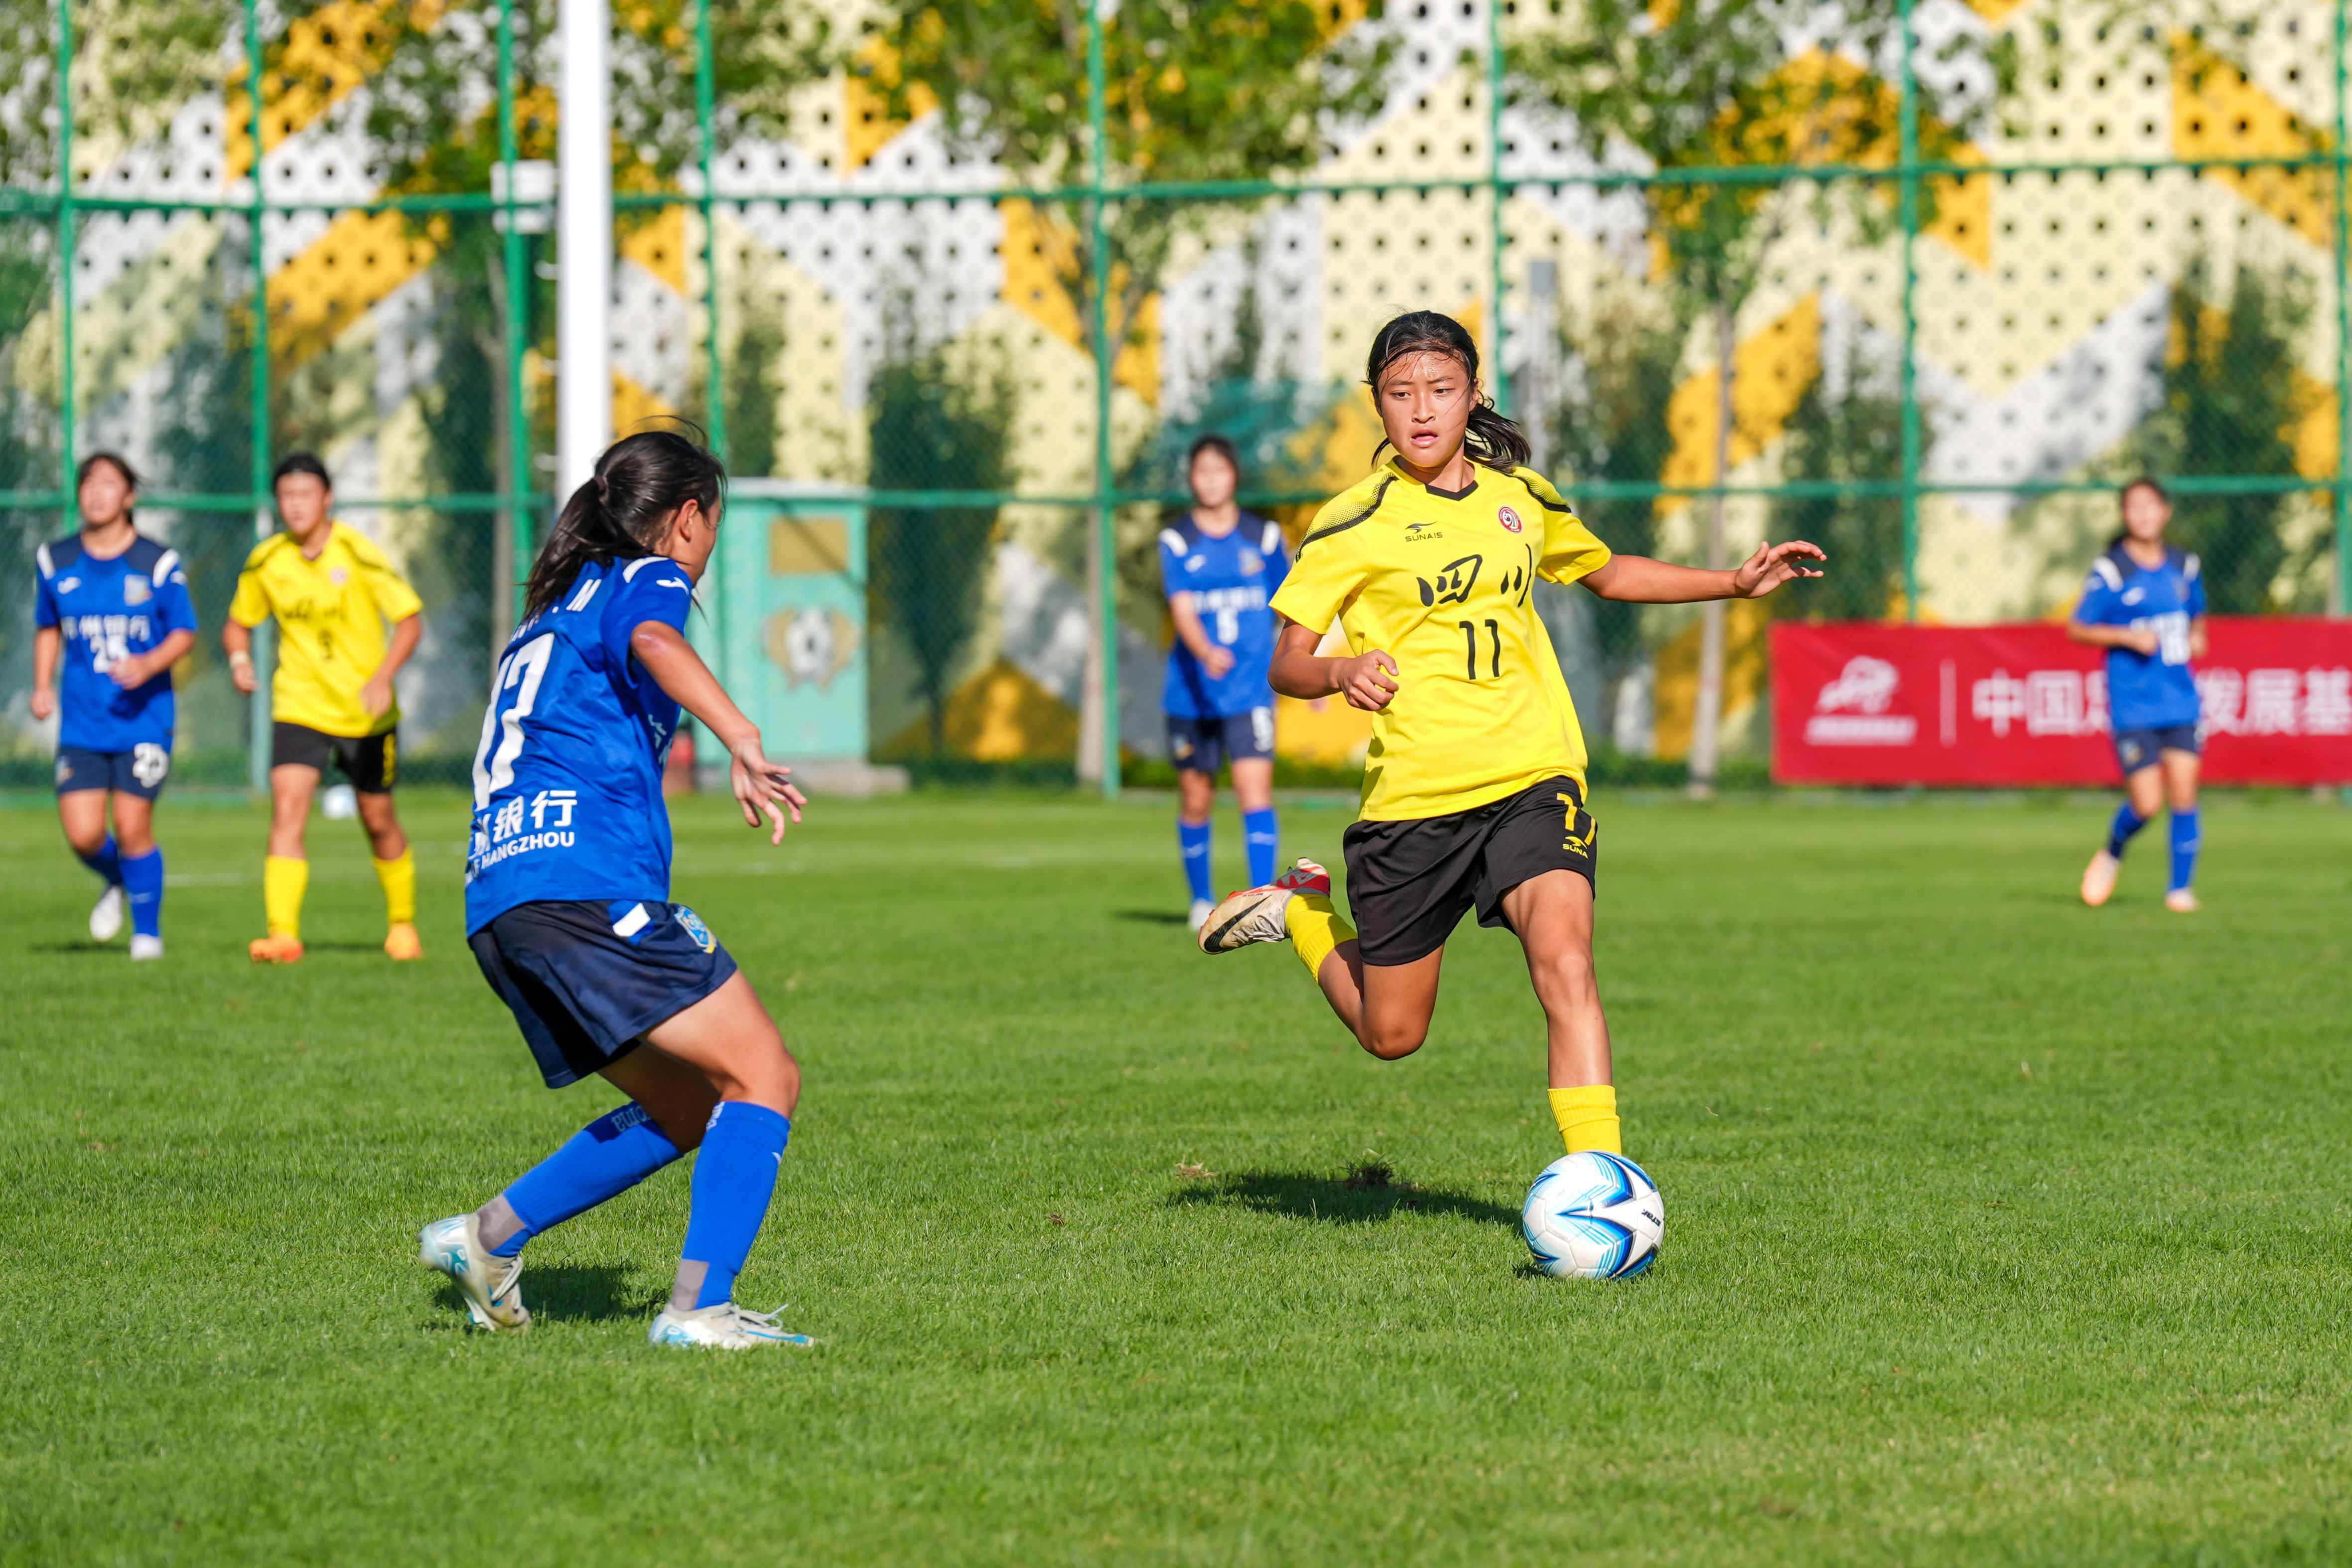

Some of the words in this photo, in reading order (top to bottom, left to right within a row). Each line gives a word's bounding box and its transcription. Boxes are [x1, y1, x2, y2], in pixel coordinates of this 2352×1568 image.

[1404, 532, 1443, 542] SUNAIS
[1416, 543, 1533, 608] 四川
[1458, 619, 1501, 681] 11
[472, 632, 555, 812] 17
[1971, 666, 2352, 738] 中国发展基
[481, 831, 575, 870] HANGZHOU
[610, 1105, 651, 1134] oma
